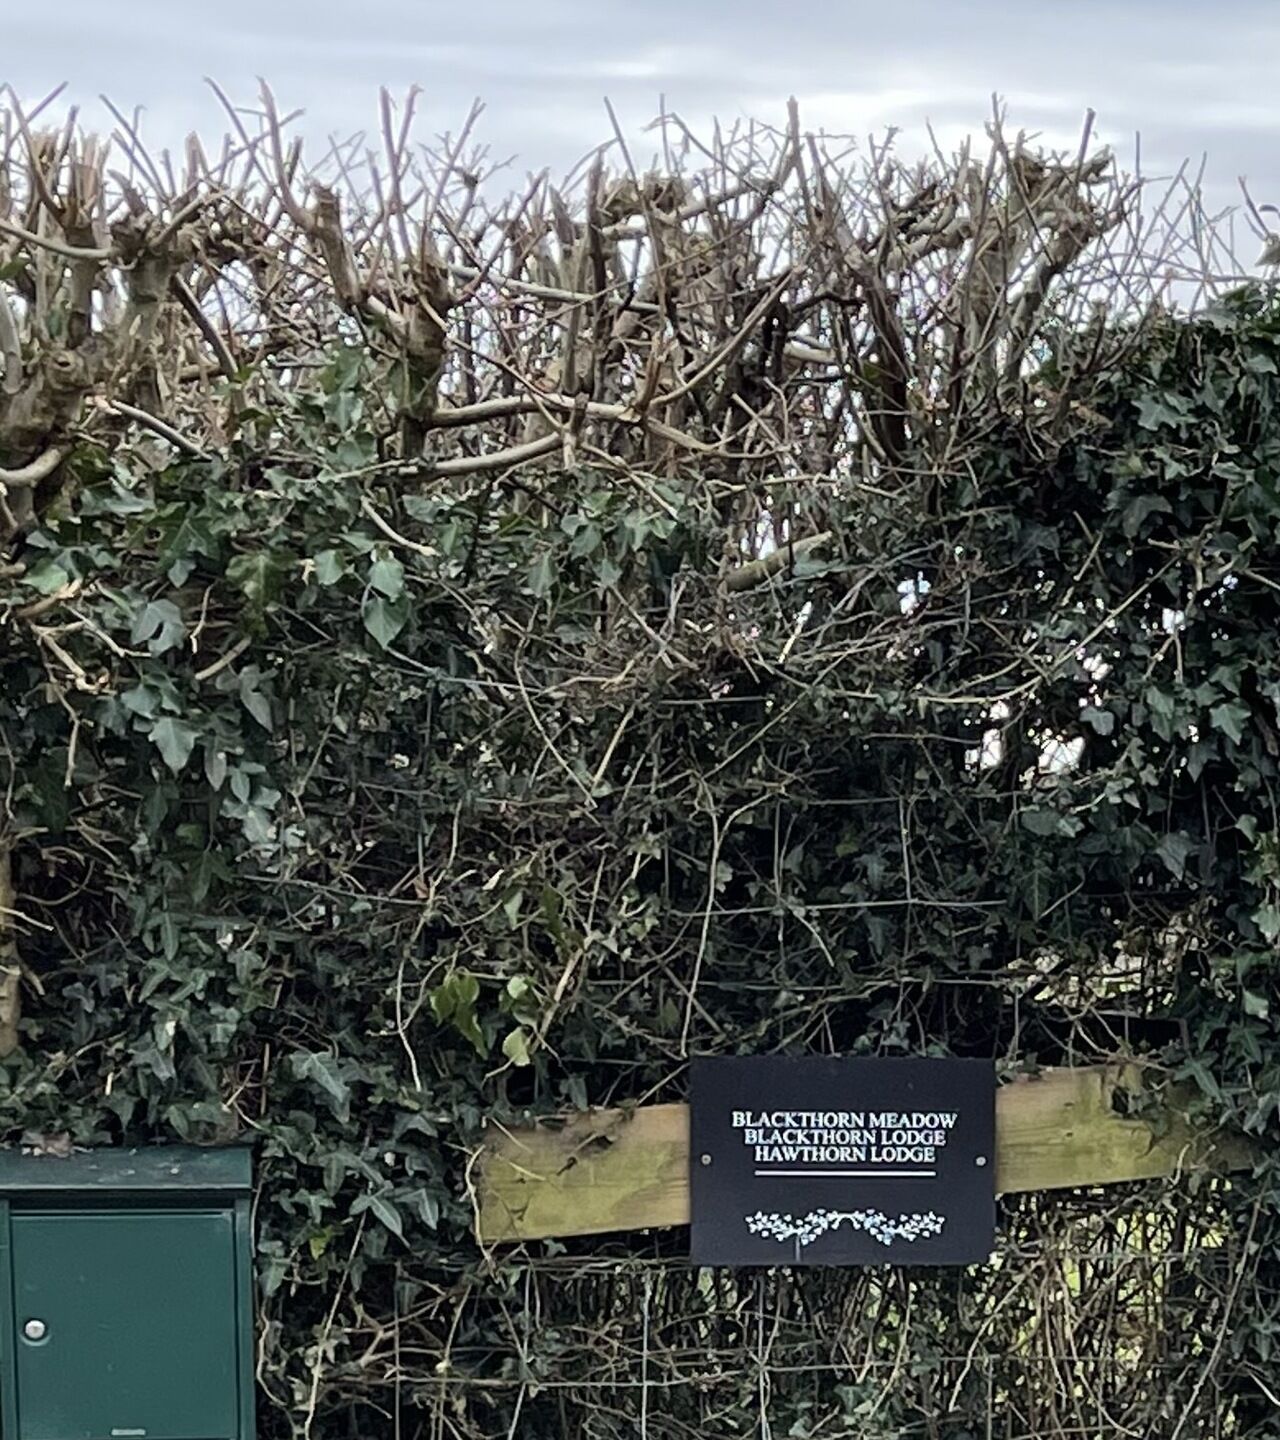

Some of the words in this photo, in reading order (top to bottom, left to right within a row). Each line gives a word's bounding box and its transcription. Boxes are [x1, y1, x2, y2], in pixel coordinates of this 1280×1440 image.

[732, 1111, 865, 1128] BLACKTHORN
[868, 1112, 957, 1129] MEADOW
[745, 1129, 877, 1145] BLACKTHORN
[881, 1130, 946, 1146] LODGE
[755, 1146, 866, 1162] HAWTHORN
[871, 1147, 935, 1163] LODGE
